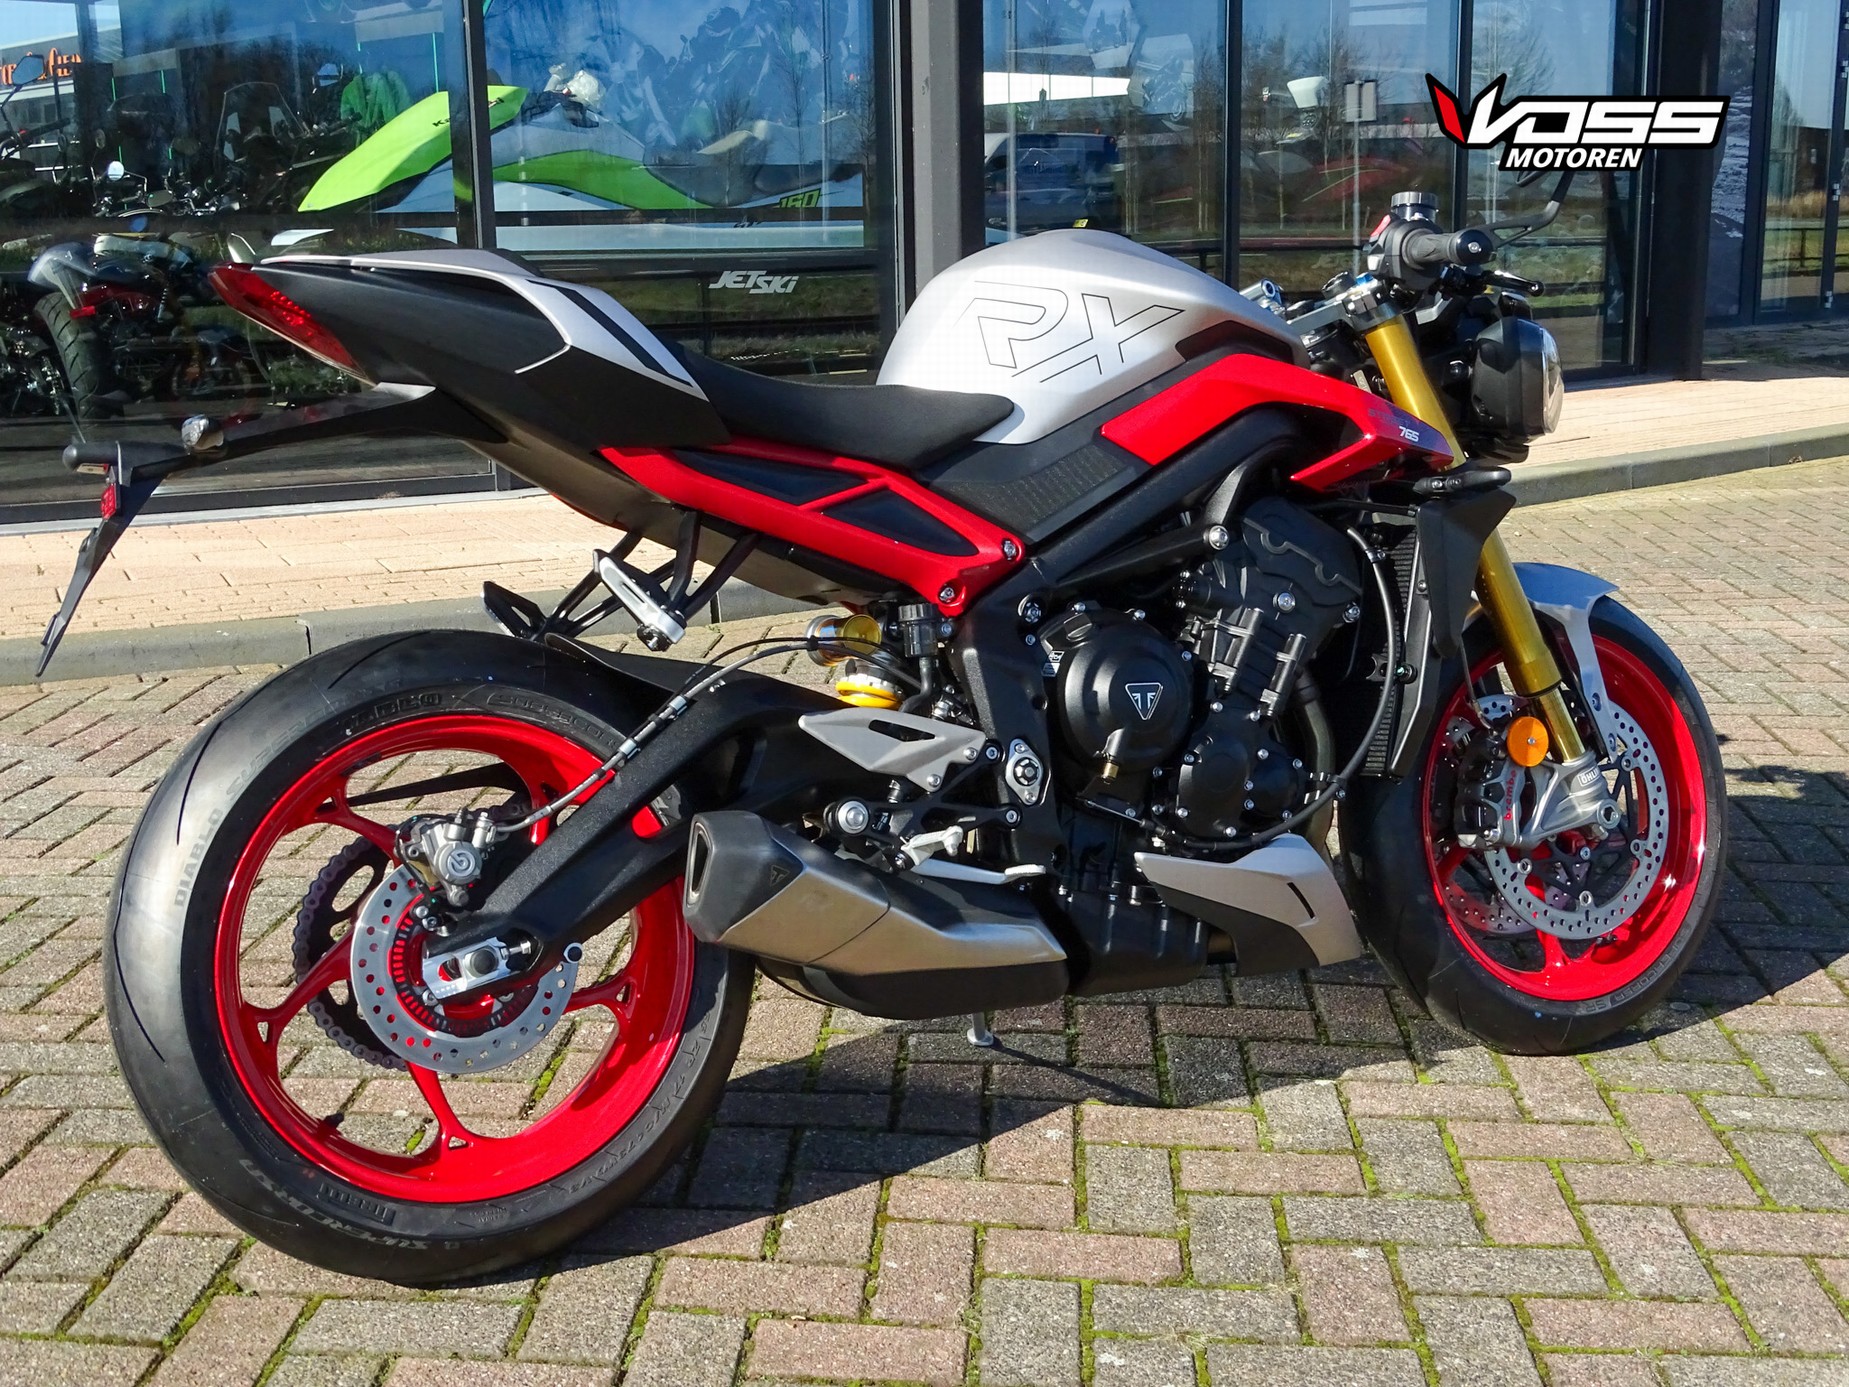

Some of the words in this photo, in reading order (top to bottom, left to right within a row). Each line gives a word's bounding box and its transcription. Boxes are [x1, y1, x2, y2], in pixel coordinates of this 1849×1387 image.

[1398, 426, 1420, 442] 765
[1503, 768, 1516, 821] brembo
[174, 807, 224, 907] DIABLO
[239, 1159, 430, 1250] SUPERCORSA
